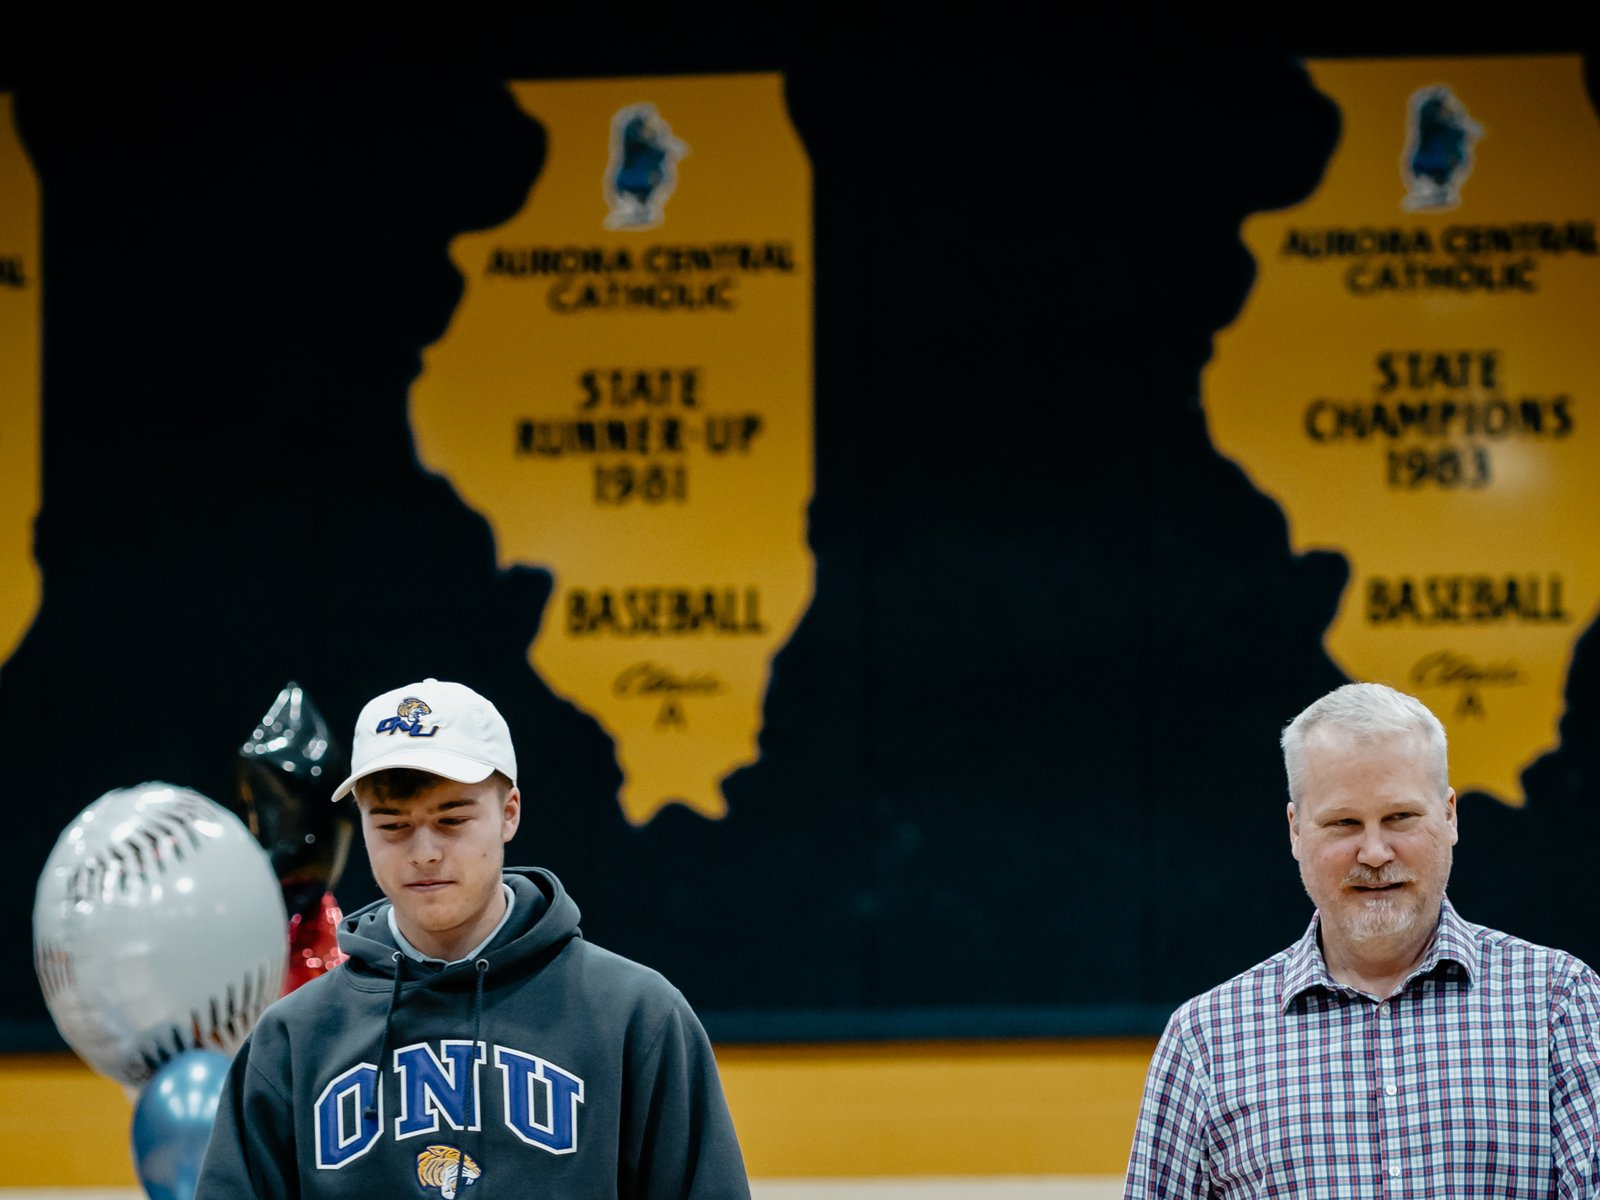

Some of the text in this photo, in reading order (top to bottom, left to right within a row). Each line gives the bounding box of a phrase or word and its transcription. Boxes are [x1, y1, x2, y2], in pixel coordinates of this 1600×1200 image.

[1282, 220, 1598, 257] AURORA CENTRAL
[487, 243, 794, 275] AURORA CENTRAL
[1346, 259, 1537, 295] CATHOLIC
[549, 279, 736, 312] CATHOLIC
[581, 369, 700, 408] STATE
[1377, 350, 1498, 391] STATE
[516, 414, 763, 457] RUNNER-UP
[1305, 396, 1574, 441] CHAMPIONS
[594, 465, 688, 504] 1981
[567, 587, 765, 637] BASEBALL
[1366, 576, 1566, 624] BASEBALL
[376, 716, 439, 738] ONU
[314, 1039, 584, 1169] ONU
